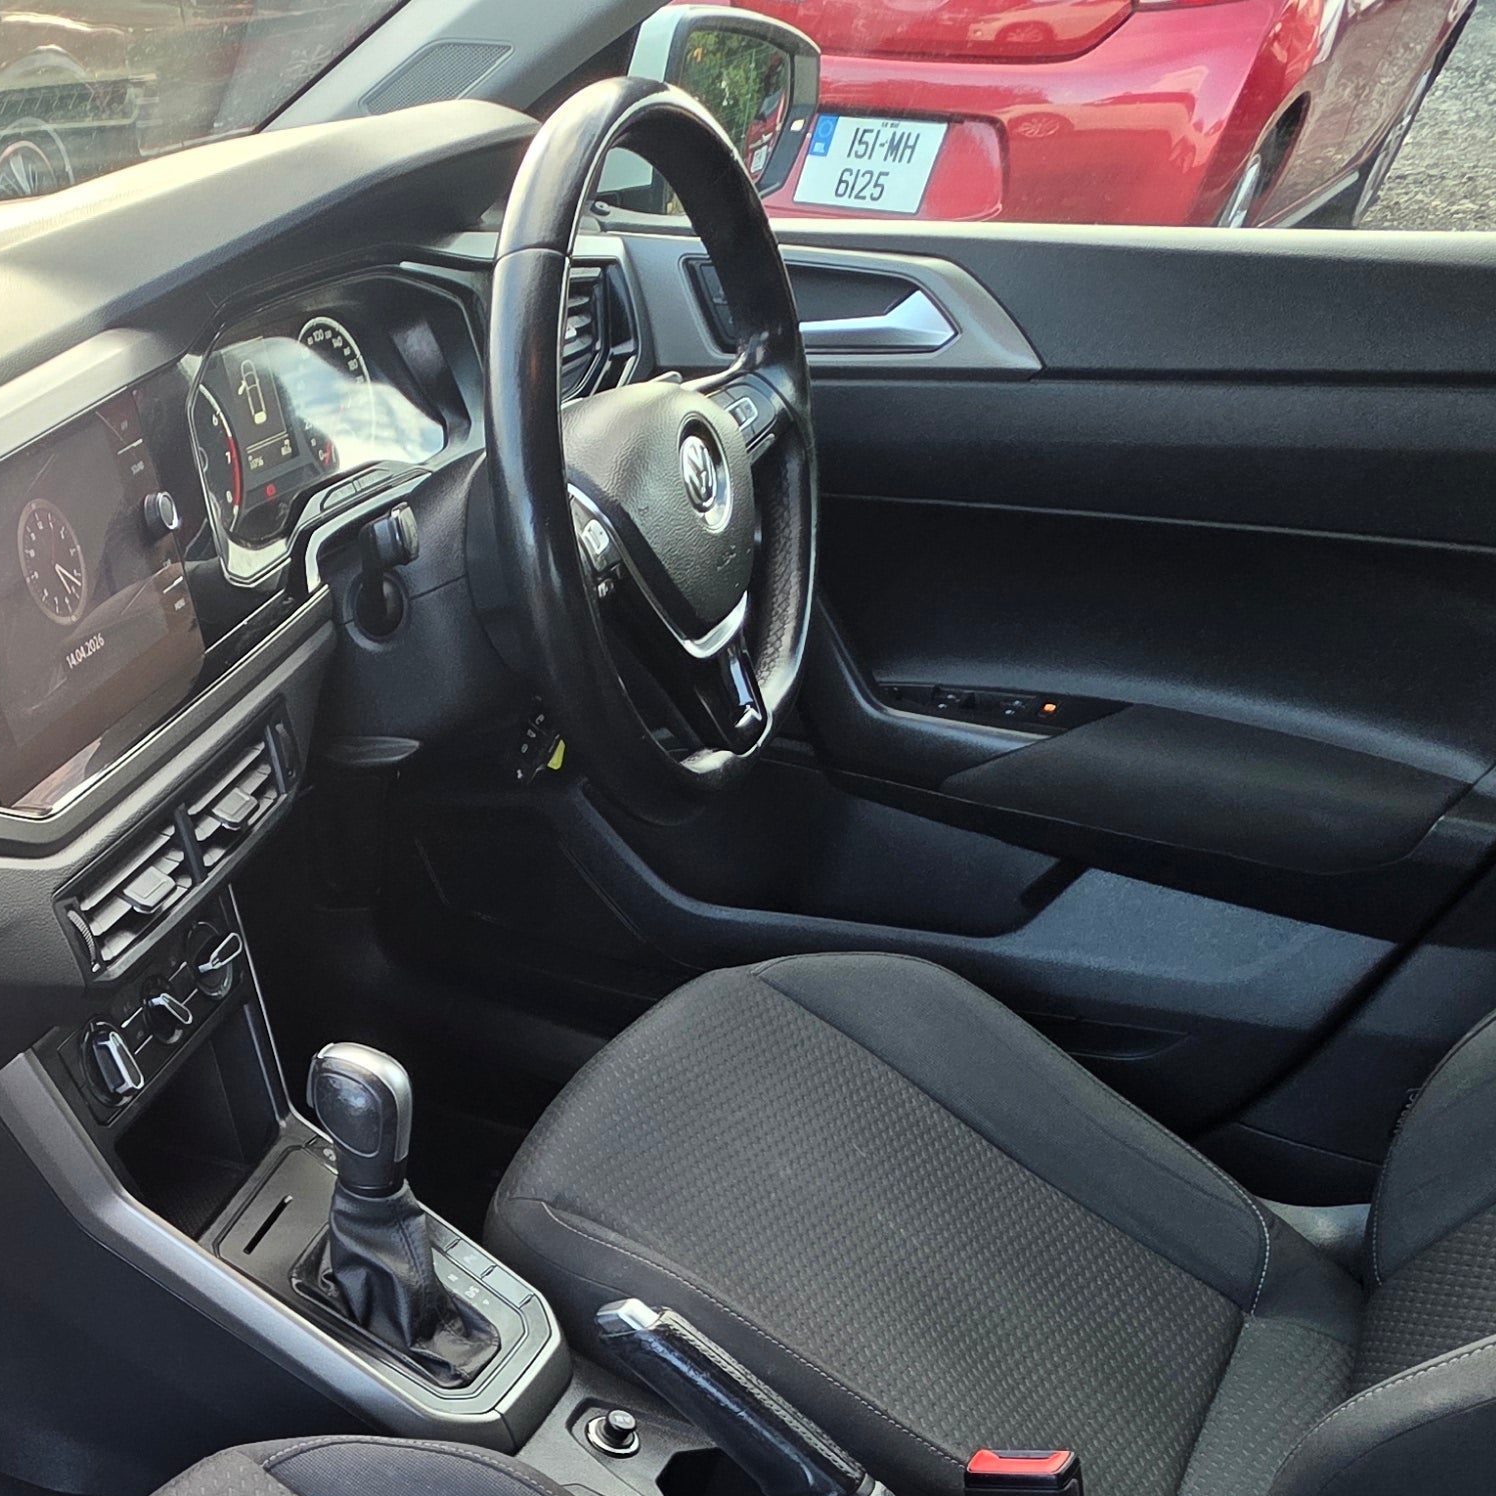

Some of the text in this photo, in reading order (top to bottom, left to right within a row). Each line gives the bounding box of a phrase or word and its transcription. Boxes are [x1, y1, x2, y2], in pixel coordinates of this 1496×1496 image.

[846, 127, 921, 164] 151-MH
[834, 168, 890, 202] 6125
[212, 415, 219, 427] 6
[65, 632, 105, 670] 14.04.2026
